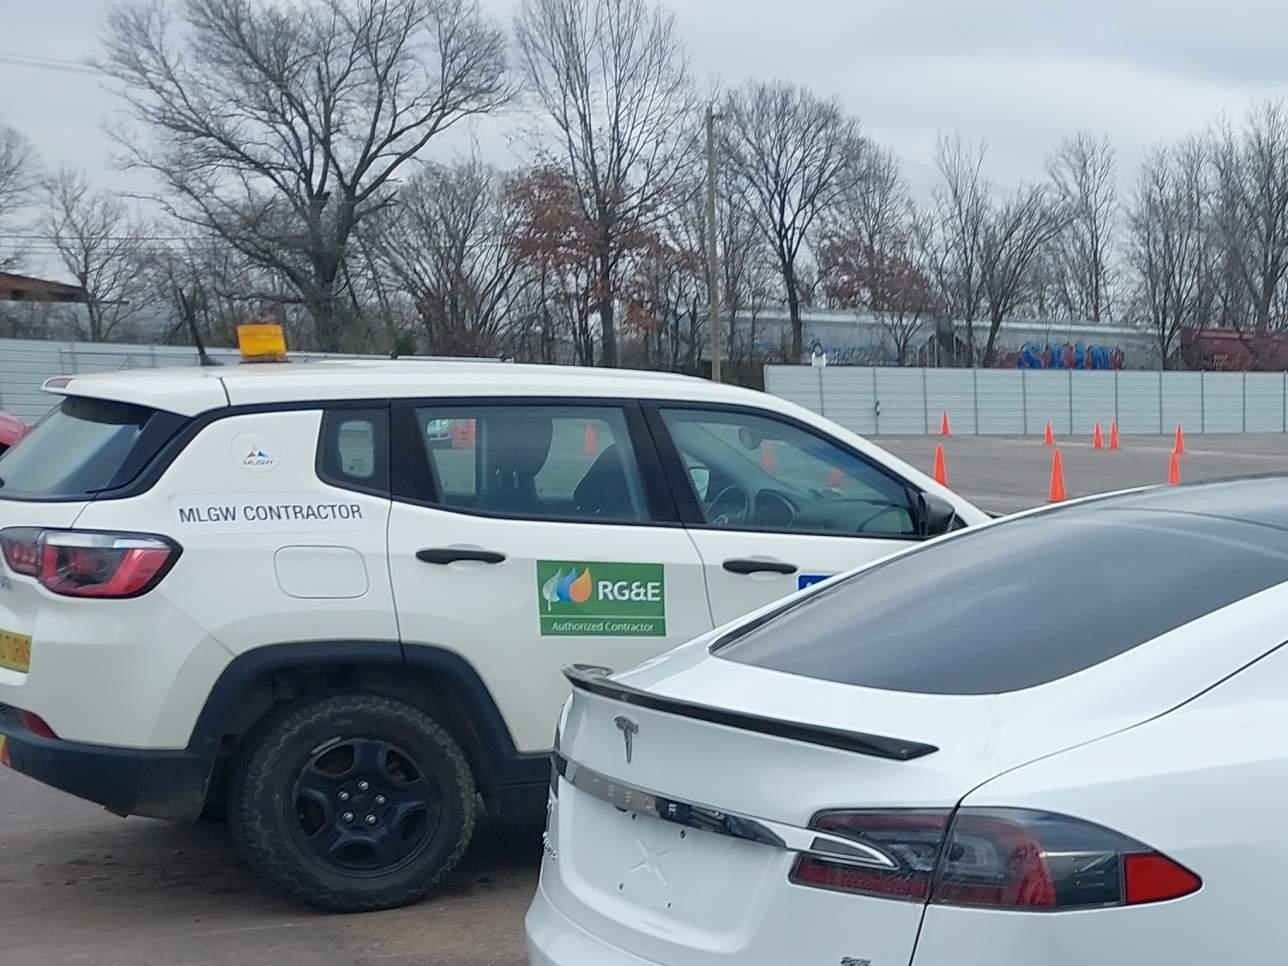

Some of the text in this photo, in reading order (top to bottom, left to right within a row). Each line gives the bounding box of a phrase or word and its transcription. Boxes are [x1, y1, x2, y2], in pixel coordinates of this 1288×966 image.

[178, 504, 363, 523] MLGW CONTRACTOR
[597, 580, 661, 601] RG&E
[552, 621, 655, 633] Authorized Contractor
